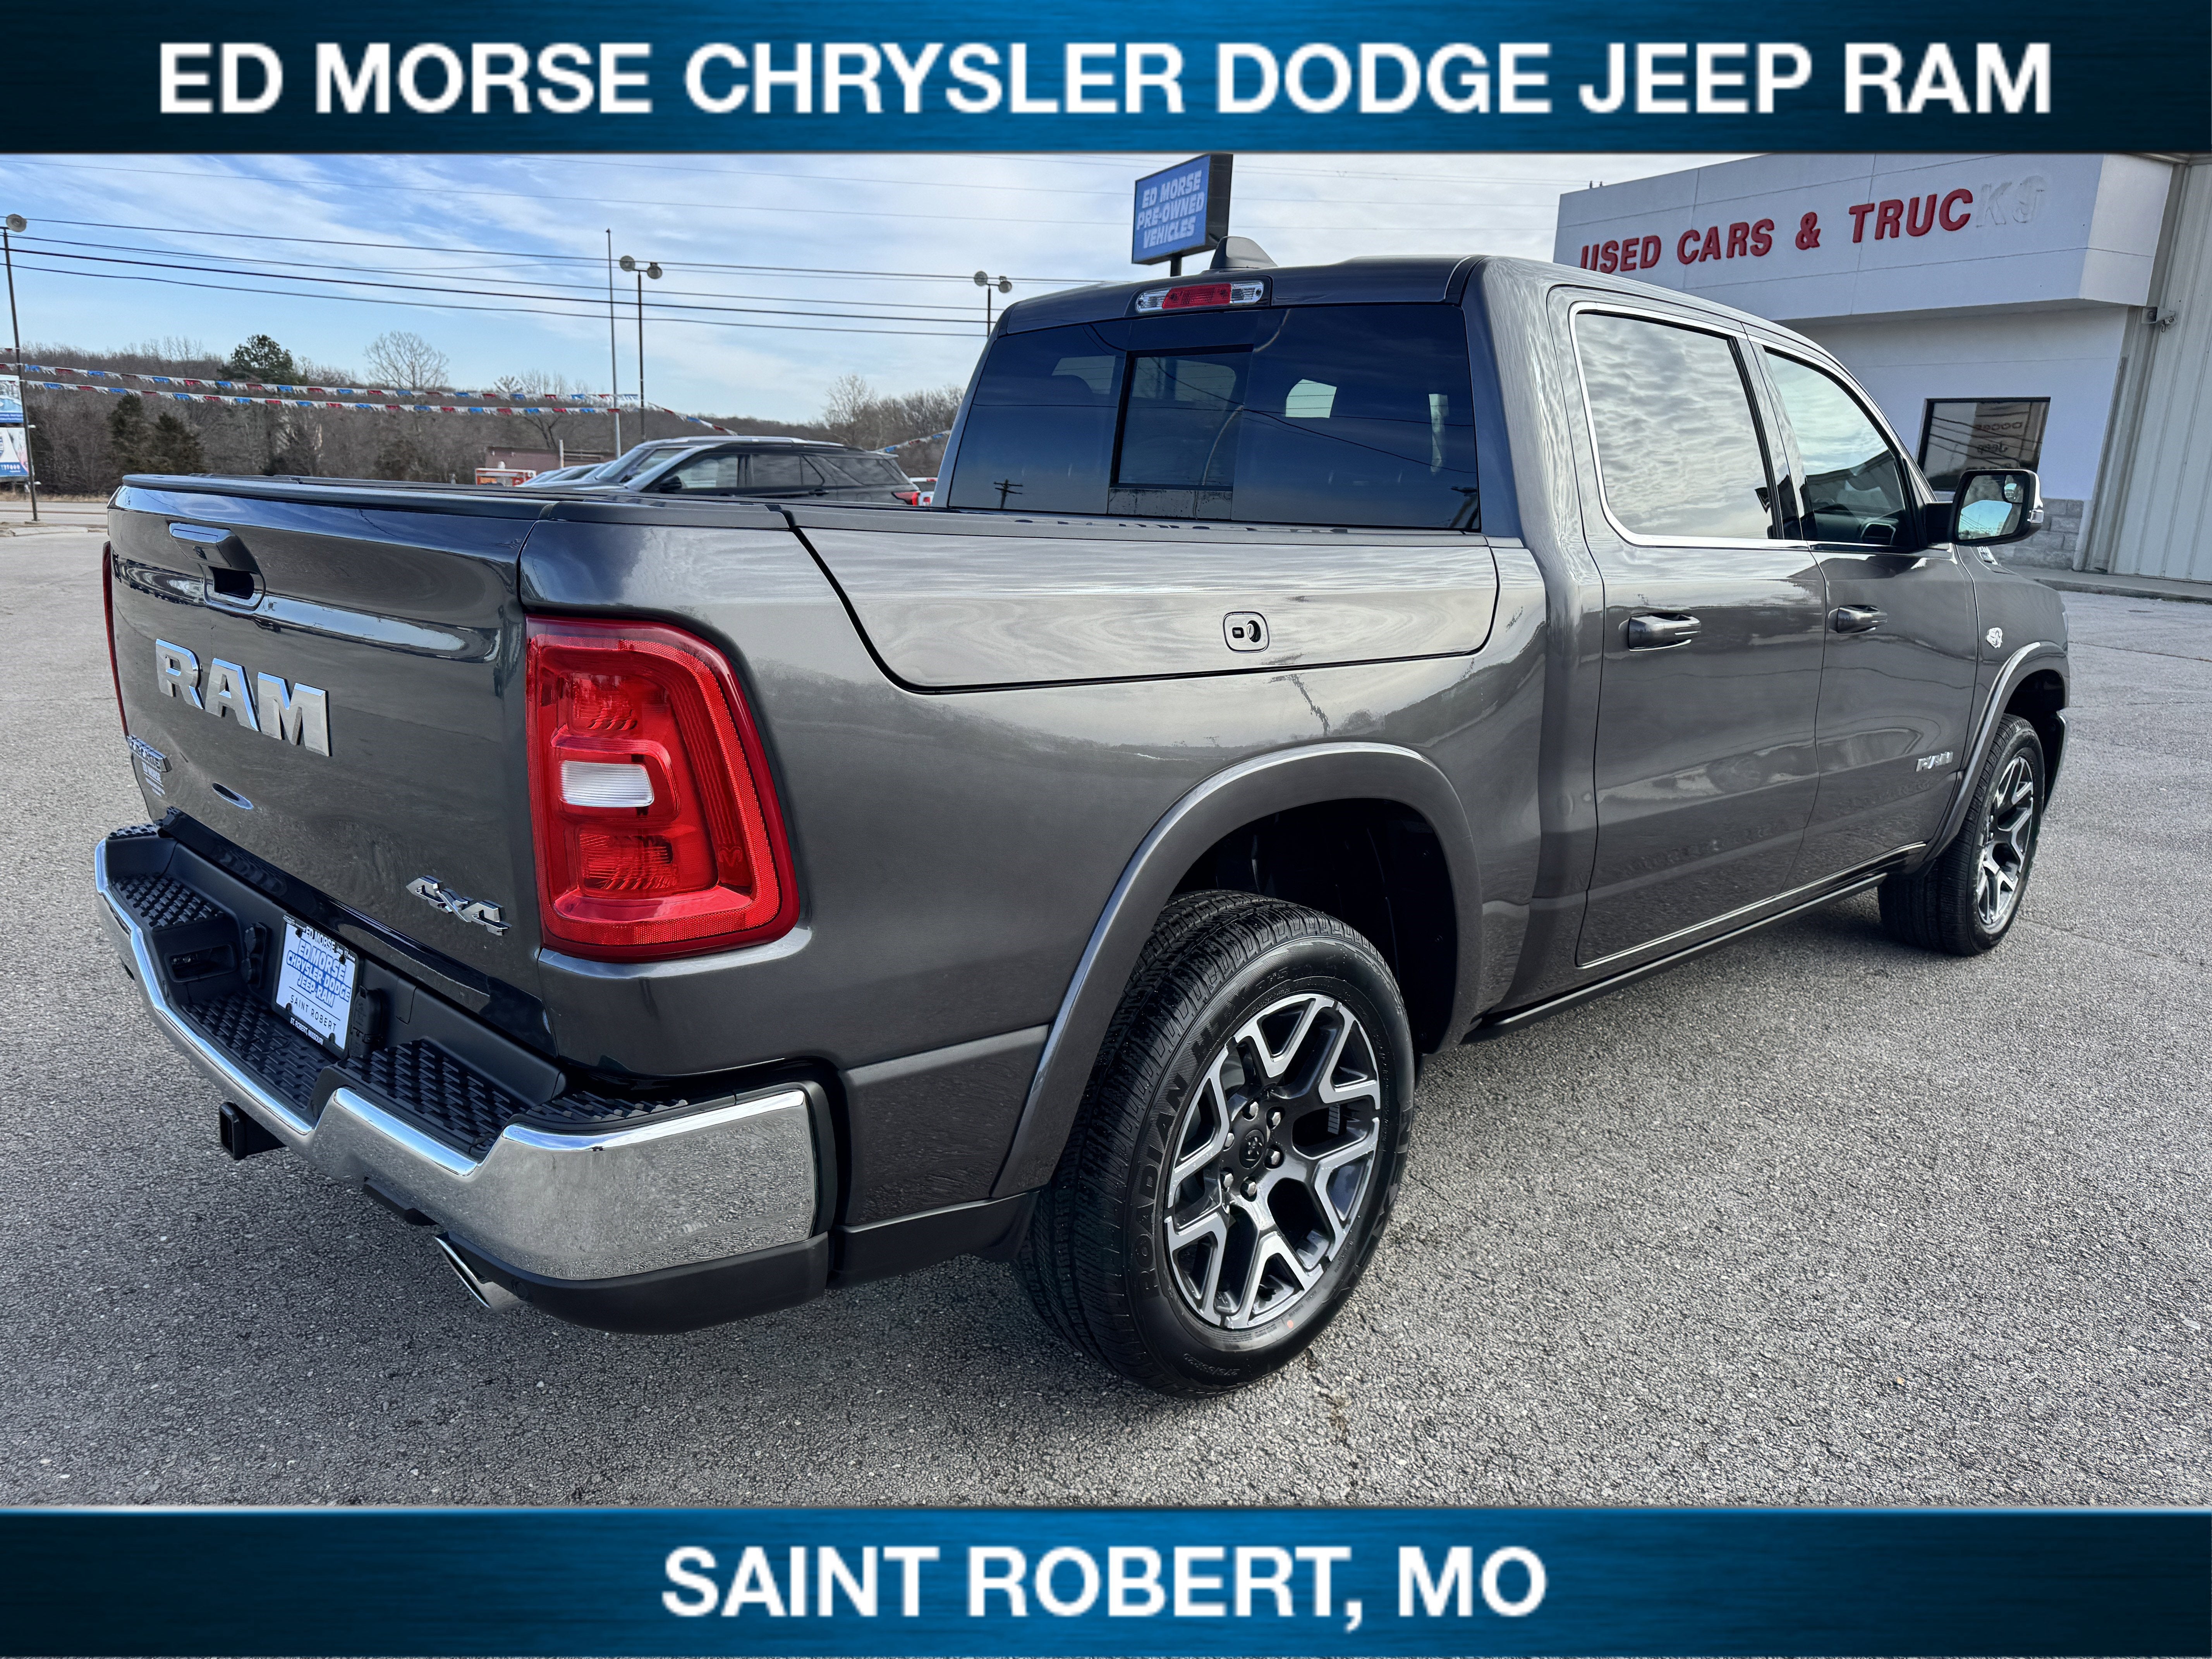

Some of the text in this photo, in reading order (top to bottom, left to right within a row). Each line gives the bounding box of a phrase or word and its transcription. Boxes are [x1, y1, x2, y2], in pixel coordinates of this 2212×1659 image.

[1142, 170, 1202, 208] ED MORSE
[1136, 192, 1205, 230] PRE-OWNED
[1144, 215, 1196, 249] VEHICLES
[1580, 235, 1662, 273] USED
[1677, 218, 1775, 264] CARS
[1795, 211, 1821, 250] &
[156, 639, 332, 757] RAM
[306, 926, 335, 952] ED MORSE
[297, 938, 347, 982] ED MORSE
[290, 994, 336, 1032] SAINT ROBERT
[1135, 1072, 1188, 1299] ROADIAN
